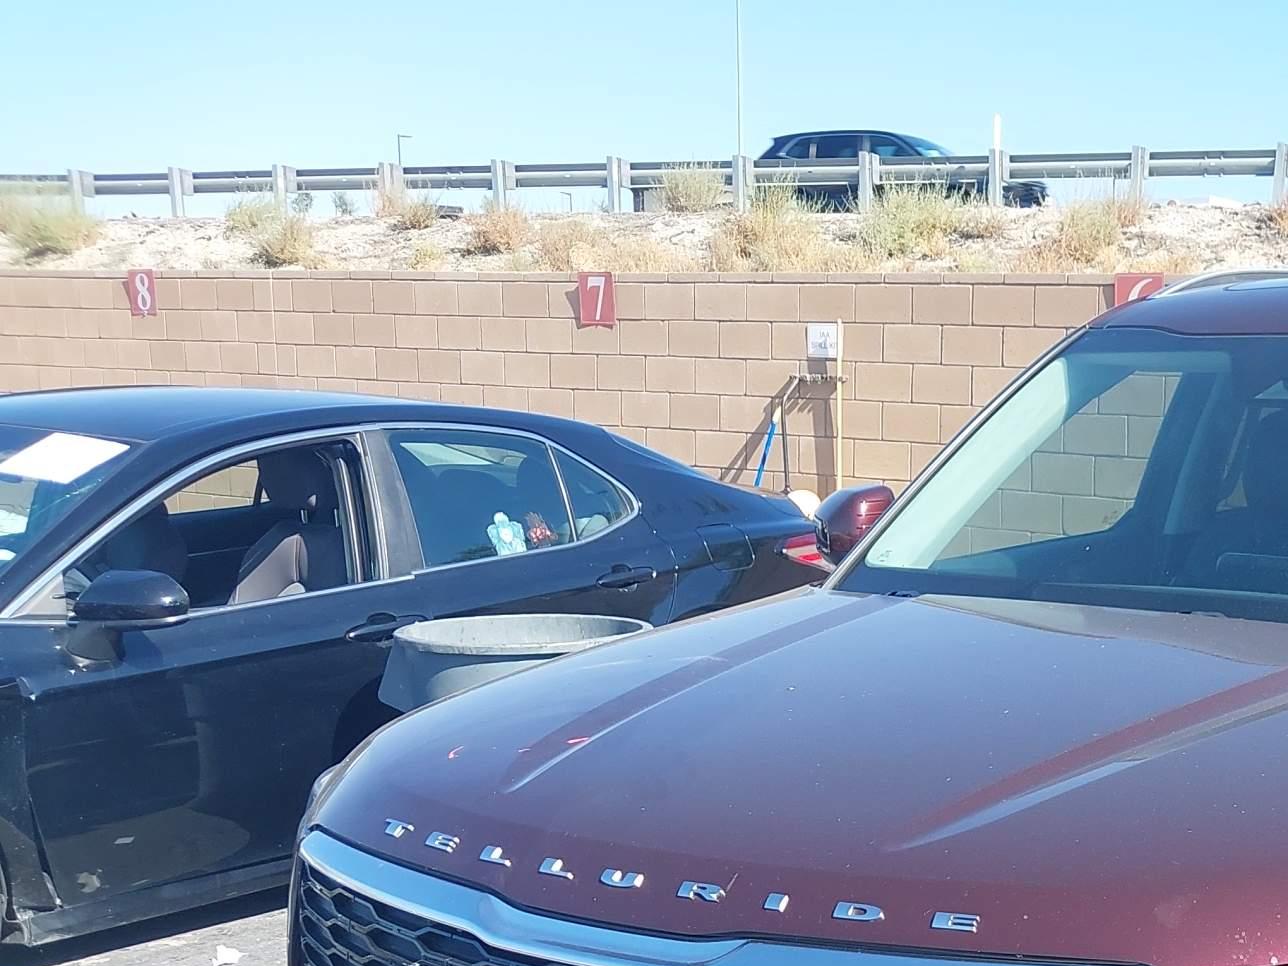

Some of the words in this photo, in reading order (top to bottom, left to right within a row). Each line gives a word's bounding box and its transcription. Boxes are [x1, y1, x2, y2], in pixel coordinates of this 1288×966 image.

[135, 273, 151, 310] 8
[587, 276, 606, 321] 7
[384, 817, 982, 934] TELLURIDE
